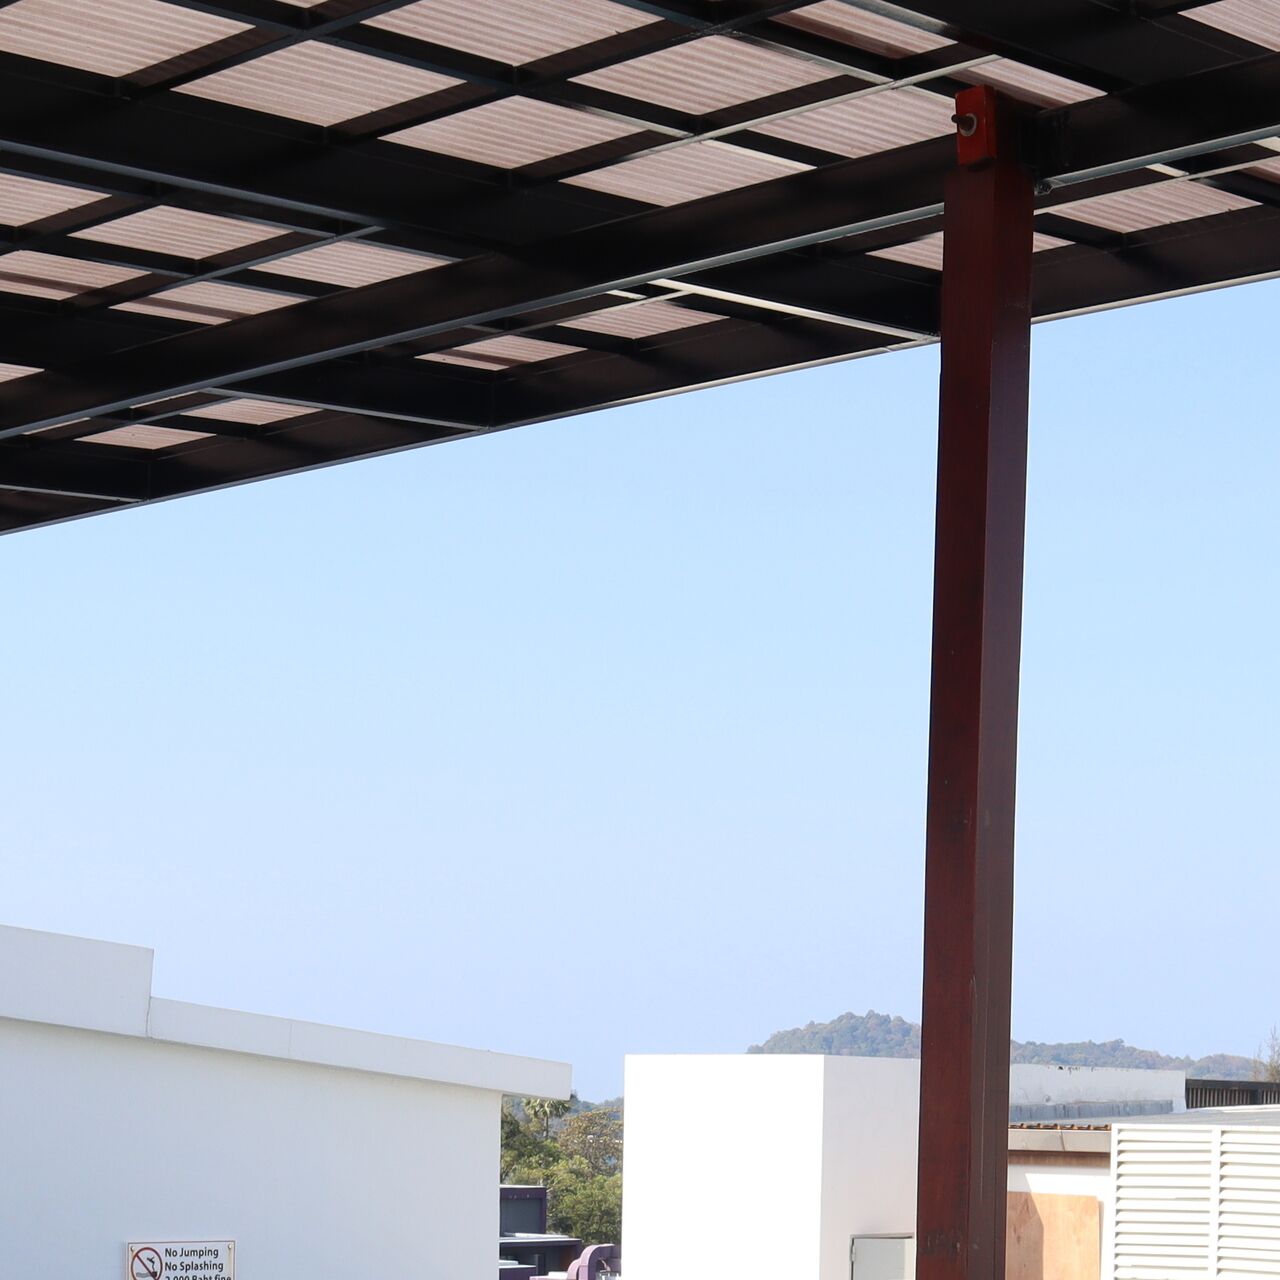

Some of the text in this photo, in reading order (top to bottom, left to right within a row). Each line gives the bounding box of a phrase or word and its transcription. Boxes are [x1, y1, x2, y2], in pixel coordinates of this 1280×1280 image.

[165, 1246, 219, 1259] No Jumping
[164, 1260, 224, 1272] No Splashing
